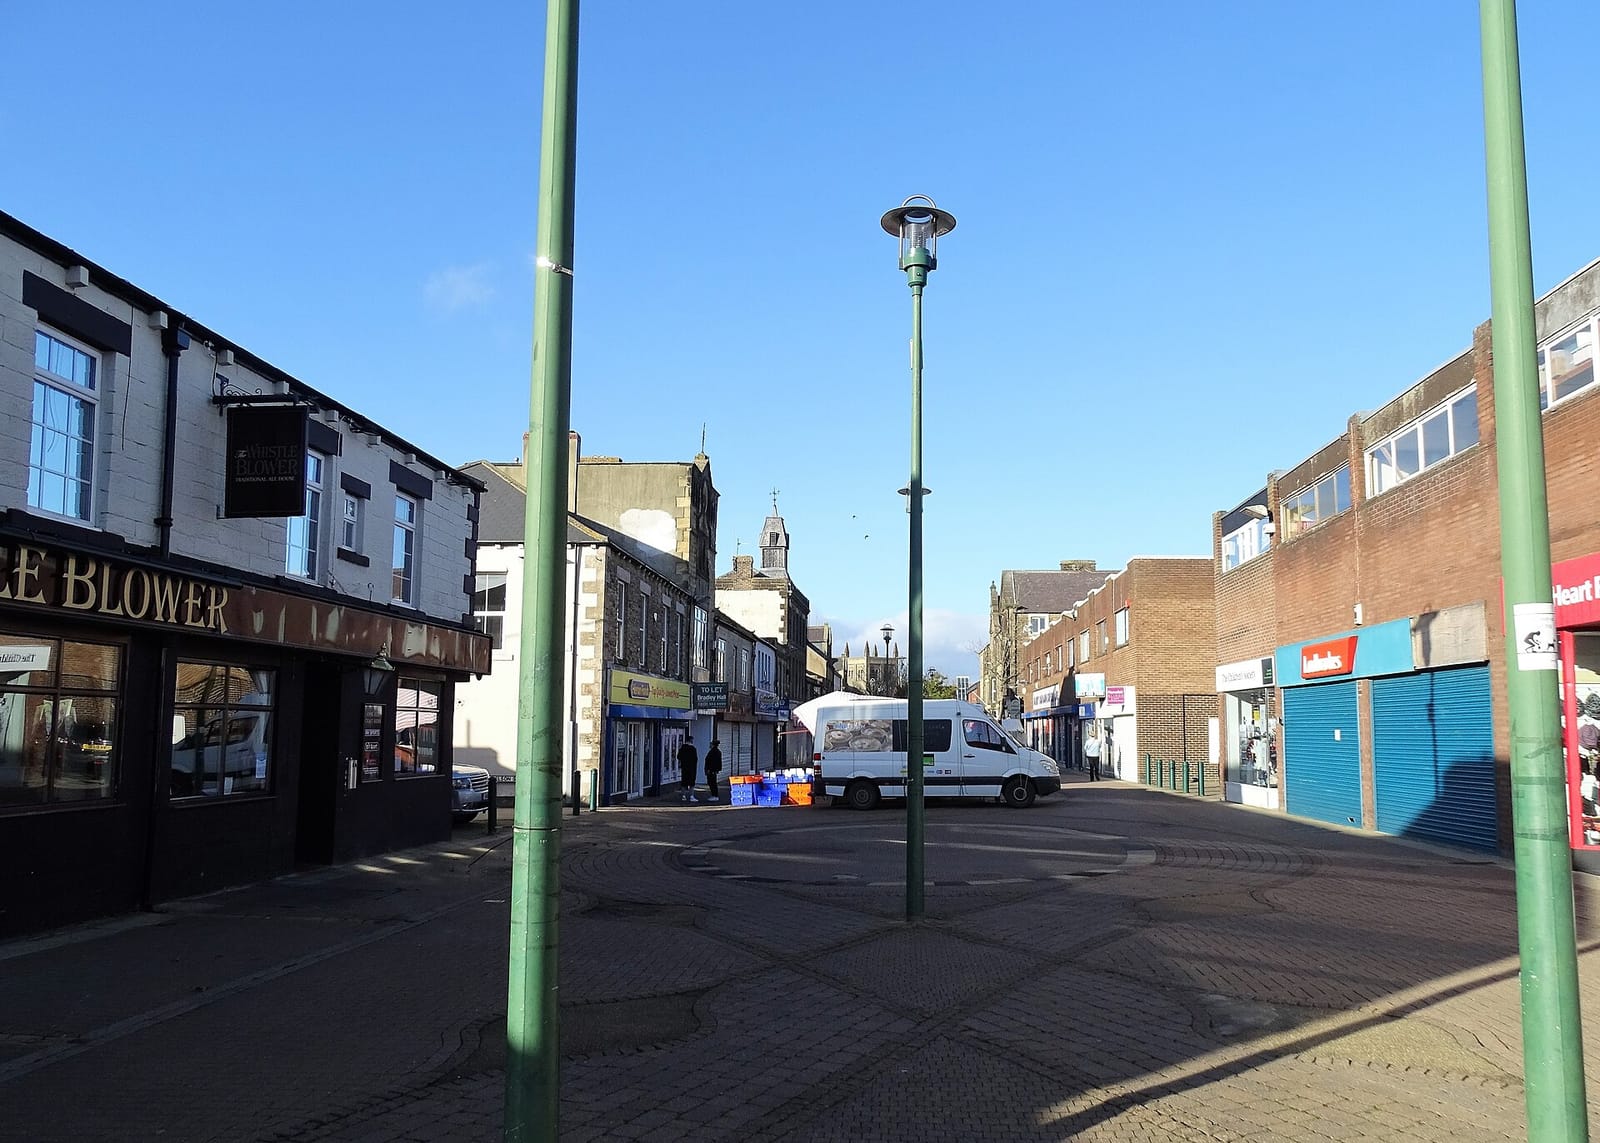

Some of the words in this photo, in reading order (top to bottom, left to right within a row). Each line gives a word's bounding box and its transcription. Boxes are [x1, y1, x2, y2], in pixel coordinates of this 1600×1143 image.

[247, 445, 297, 458] WHISTLE
[236, 459, 298, 475] BLOWER
[62, 554, 229, 634] BLOWER
[1552, 579, 1593, 607] Heart
[701, 686, 710, 694] TO
[710, 686, 723, 694] LET
